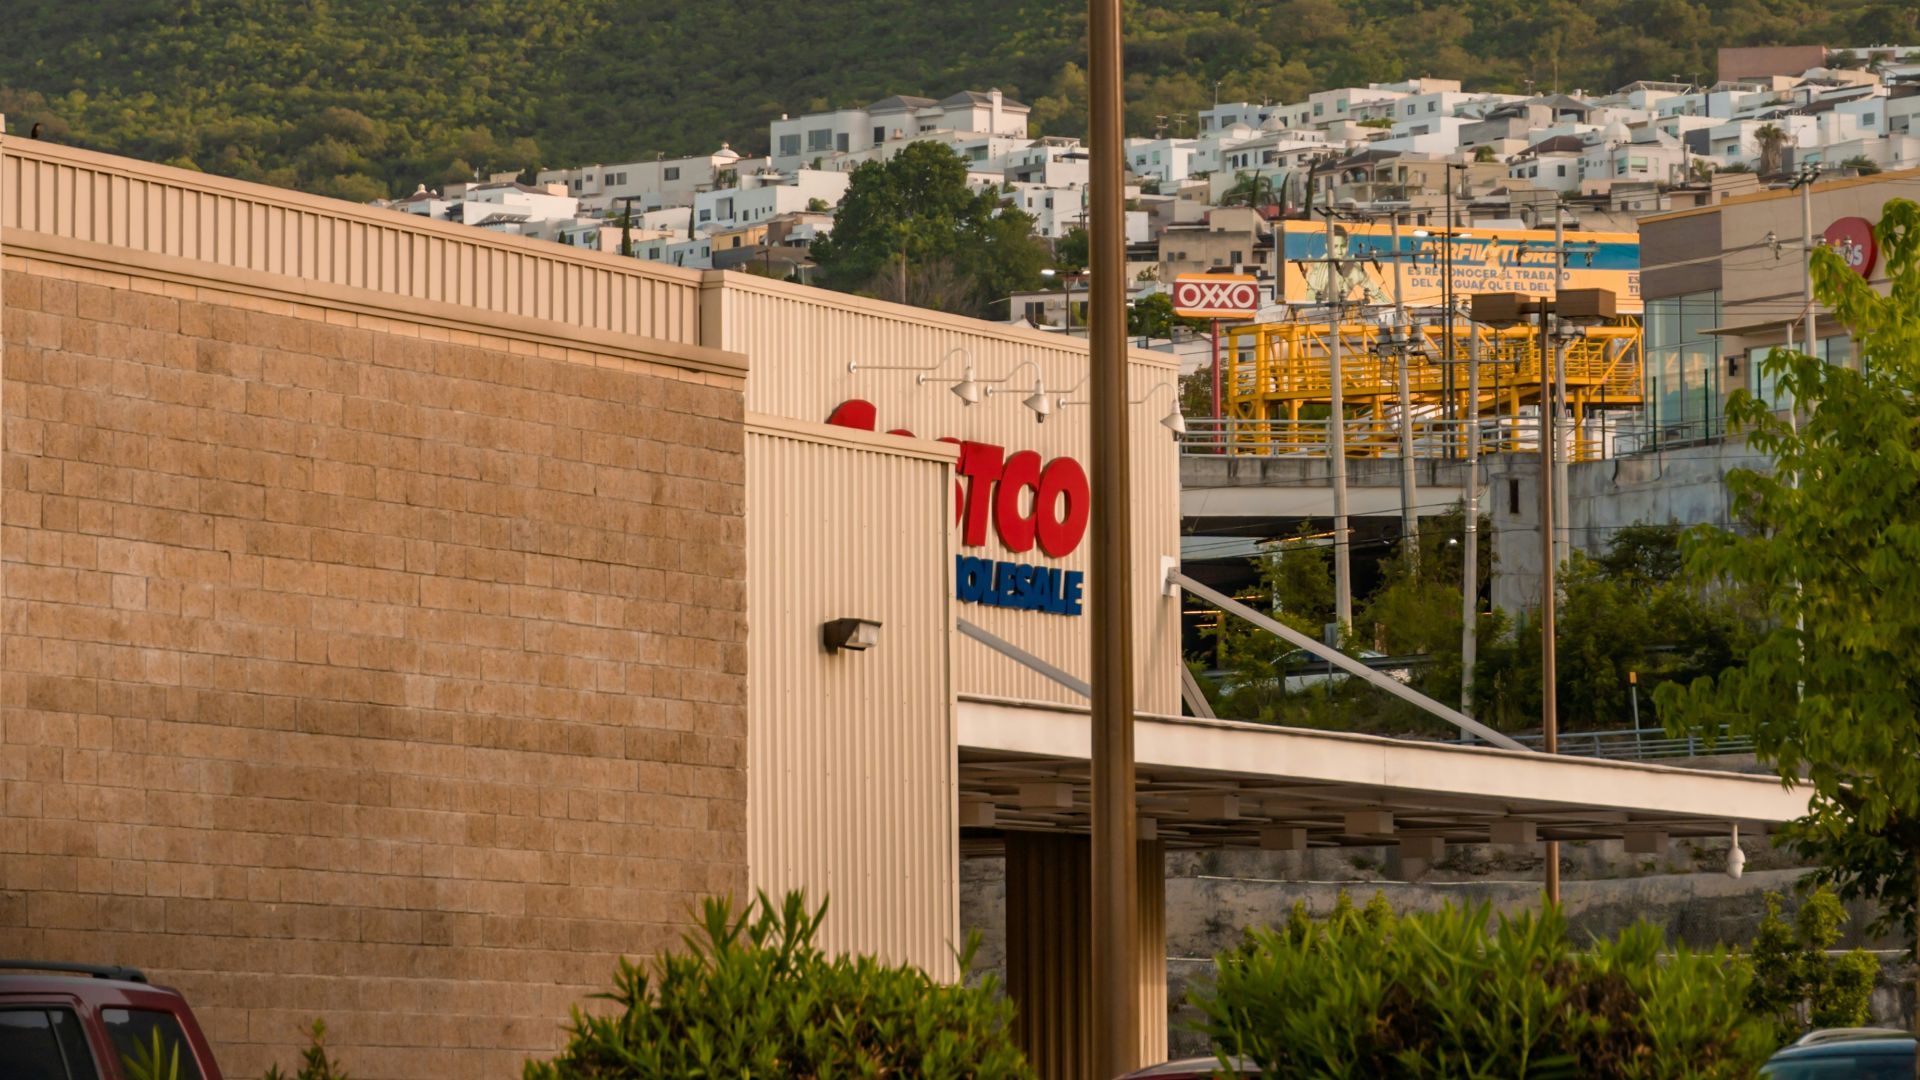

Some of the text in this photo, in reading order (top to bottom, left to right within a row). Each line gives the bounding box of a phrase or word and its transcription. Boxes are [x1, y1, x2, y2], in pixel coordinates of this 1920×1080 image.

[1407, 266, 1421, 276] ES
[1516, 270, 1570, 281] TRABAO
[1411, 278, 1432, 288] DEL
[1453, 279, 1485, 290] GUAL
[1487, 280, 1511, 291] QUE
[1514, 281, 1527, 291] EL
[1529, 282, 1550, 292] DEL
[1179, 283, 1254, 308] OXXO
[956, 554, 1084, 616] OLESALE
